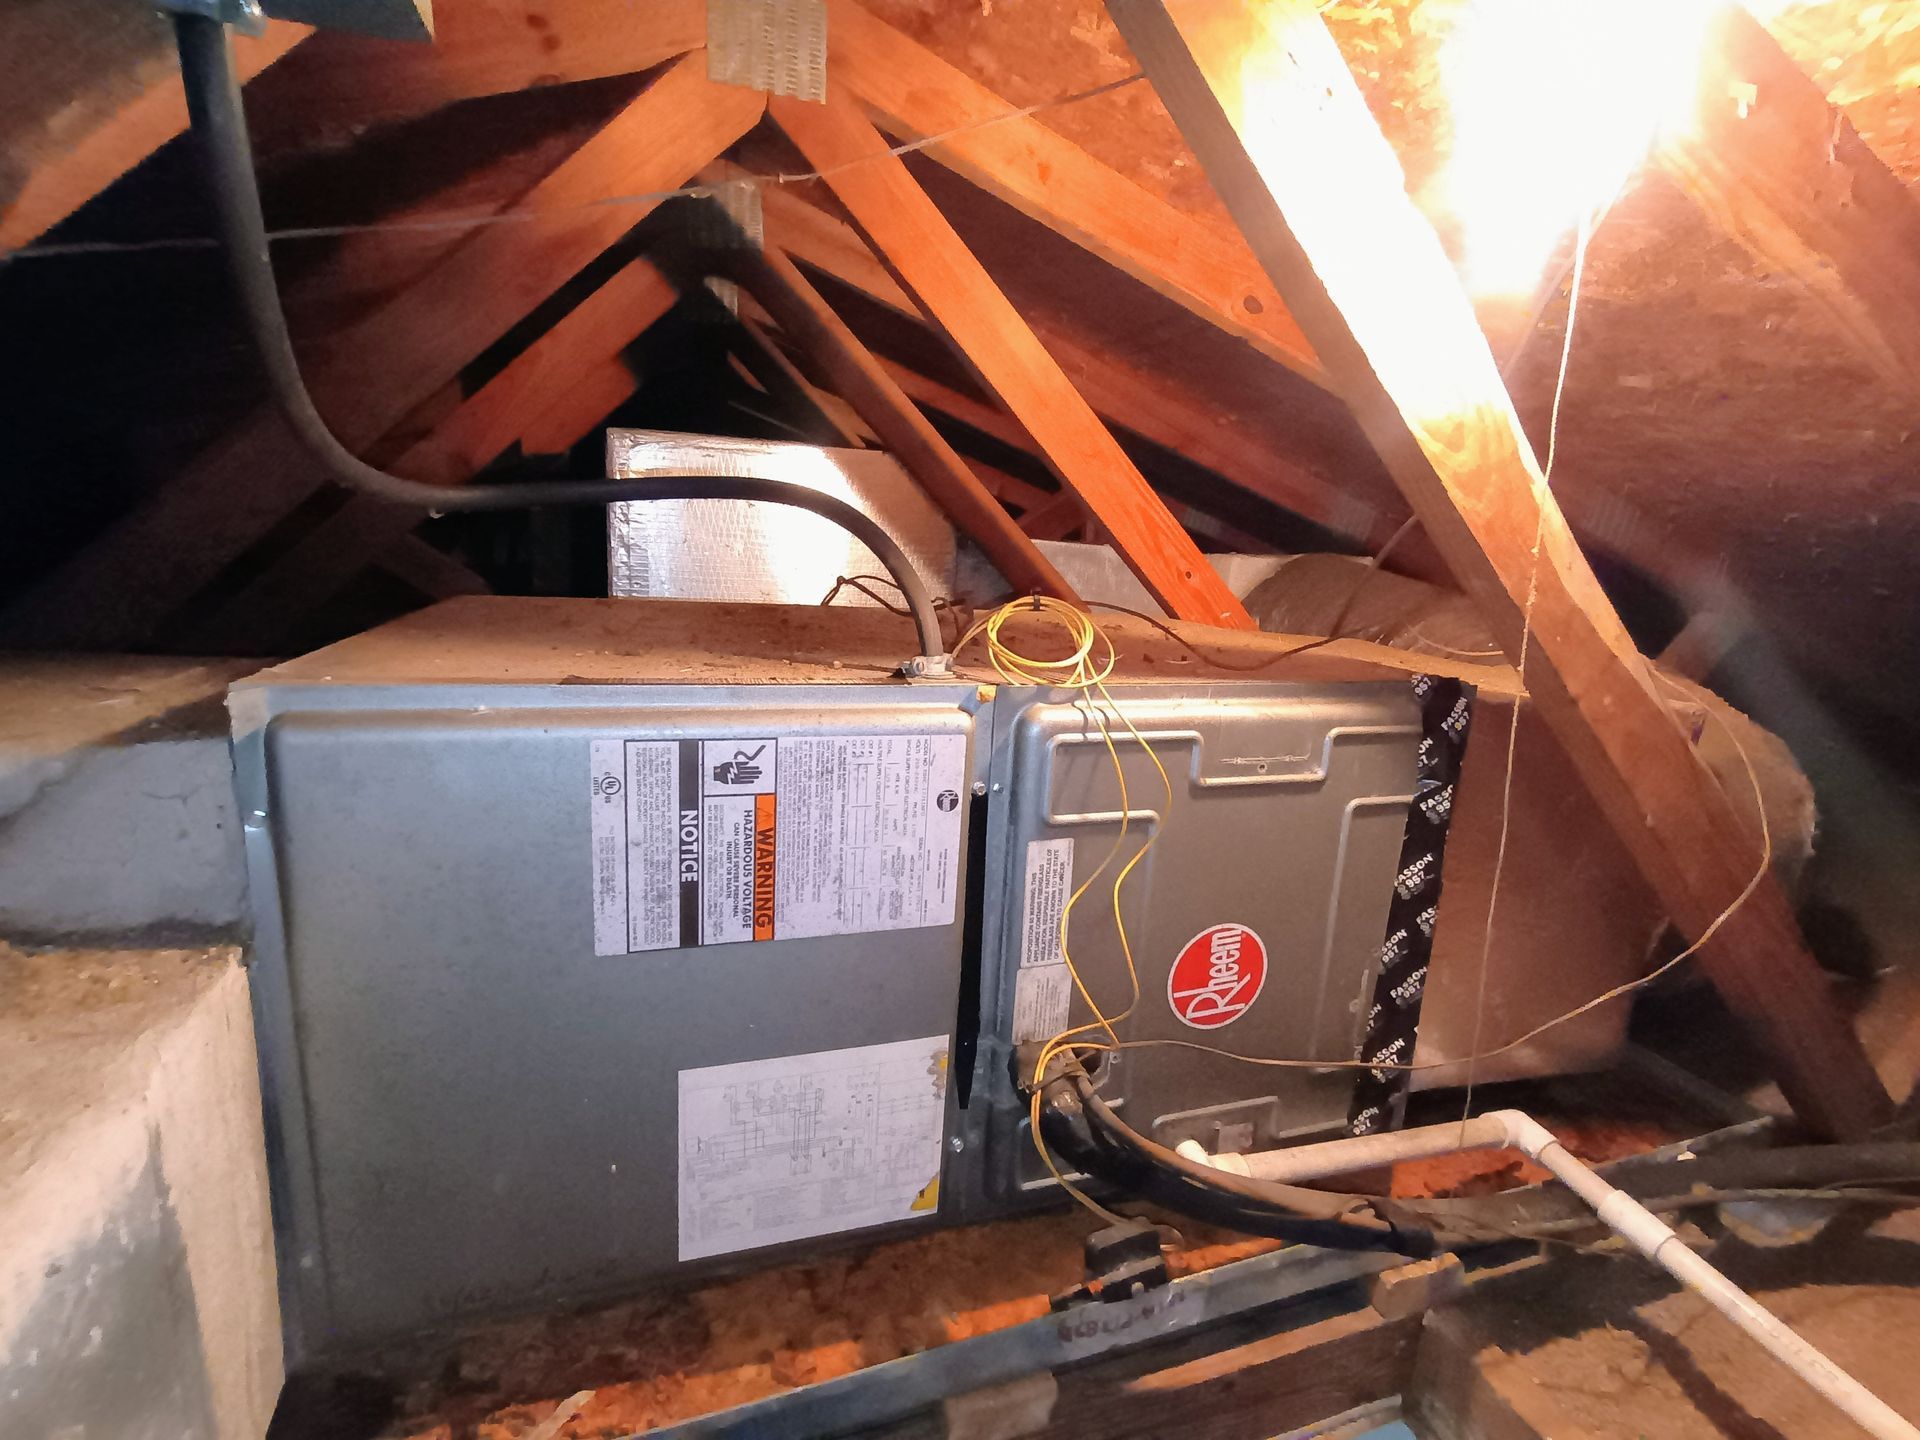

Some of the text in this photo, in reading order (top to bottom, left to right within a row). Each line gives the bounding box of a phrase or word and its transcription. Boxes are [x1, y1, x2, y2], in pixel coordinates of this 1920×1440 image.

[1415, 677, 1432, 696] 957
[1441, 697, 1468, 731] FASSON
[1454, 711, 1470, 731] 957
[1435, 796, 1451, 813] 95
[680, 809, 697, 882] NOTICE
[1046, 848, 1052, 856] OF
[725, 866, 732, 876] OR
[742, 809, 752, 929] HAZARDOUS VOLTAGE
[755, 827, 773, 928] WARNING
[1044, 857, 1052, 889] PARTICLES
[1405, 871, 1426, 888] 957
[1032, 863, 1044, 962] APPLIANCE CONTAINS FIBERGLASS
[1042, 890, 1050, 925] RESPIRABLE
[1046, 925, 1054, 960] FIBERGLASS
[1051, 880, 1056, 888] TO
[1416, 905, 1437, 925] FAS
[1025, 924, 1033, 963] PROPOSITION
[1053, 950, 1059, 959] OF
[1056, 907, 1062, 916] TO
[1381, 929, 1408, 954] SSON
[1382, 945, 1399, 963] 957
[1173, 929, 1251, 1020] Rheem
[1390, 966, 1428, 998] FASSON
[1403, 981, 1421, 998] 957
[1370, 1038, 1406, 1066] ASSON
[1353, 1106, 1380, 1127] SSON
[1353, 1119, 1373, 1136] 957
